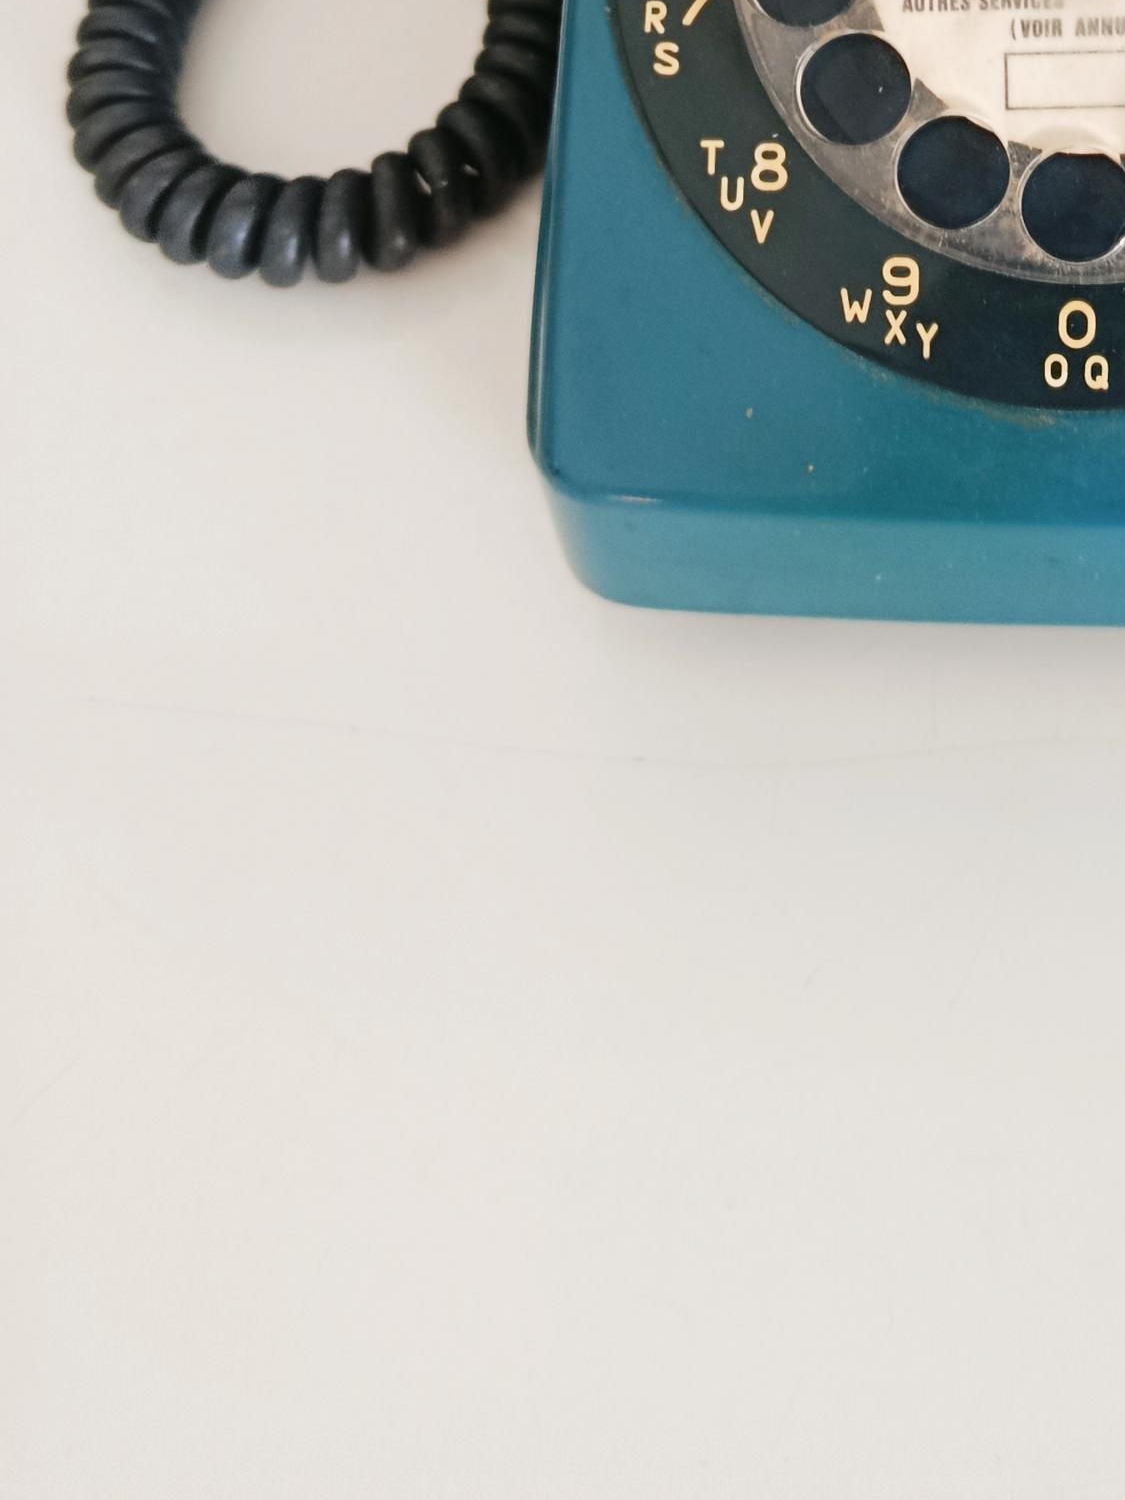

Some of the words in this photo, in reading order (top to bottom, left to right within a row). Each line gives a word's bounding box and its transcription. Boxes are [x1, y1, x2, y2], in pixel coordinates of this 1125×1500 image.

[1010, 17, 1063, 40] (VOIR
[750, 142, 788, 192] 8
[882, 256, 920, 306] 9
